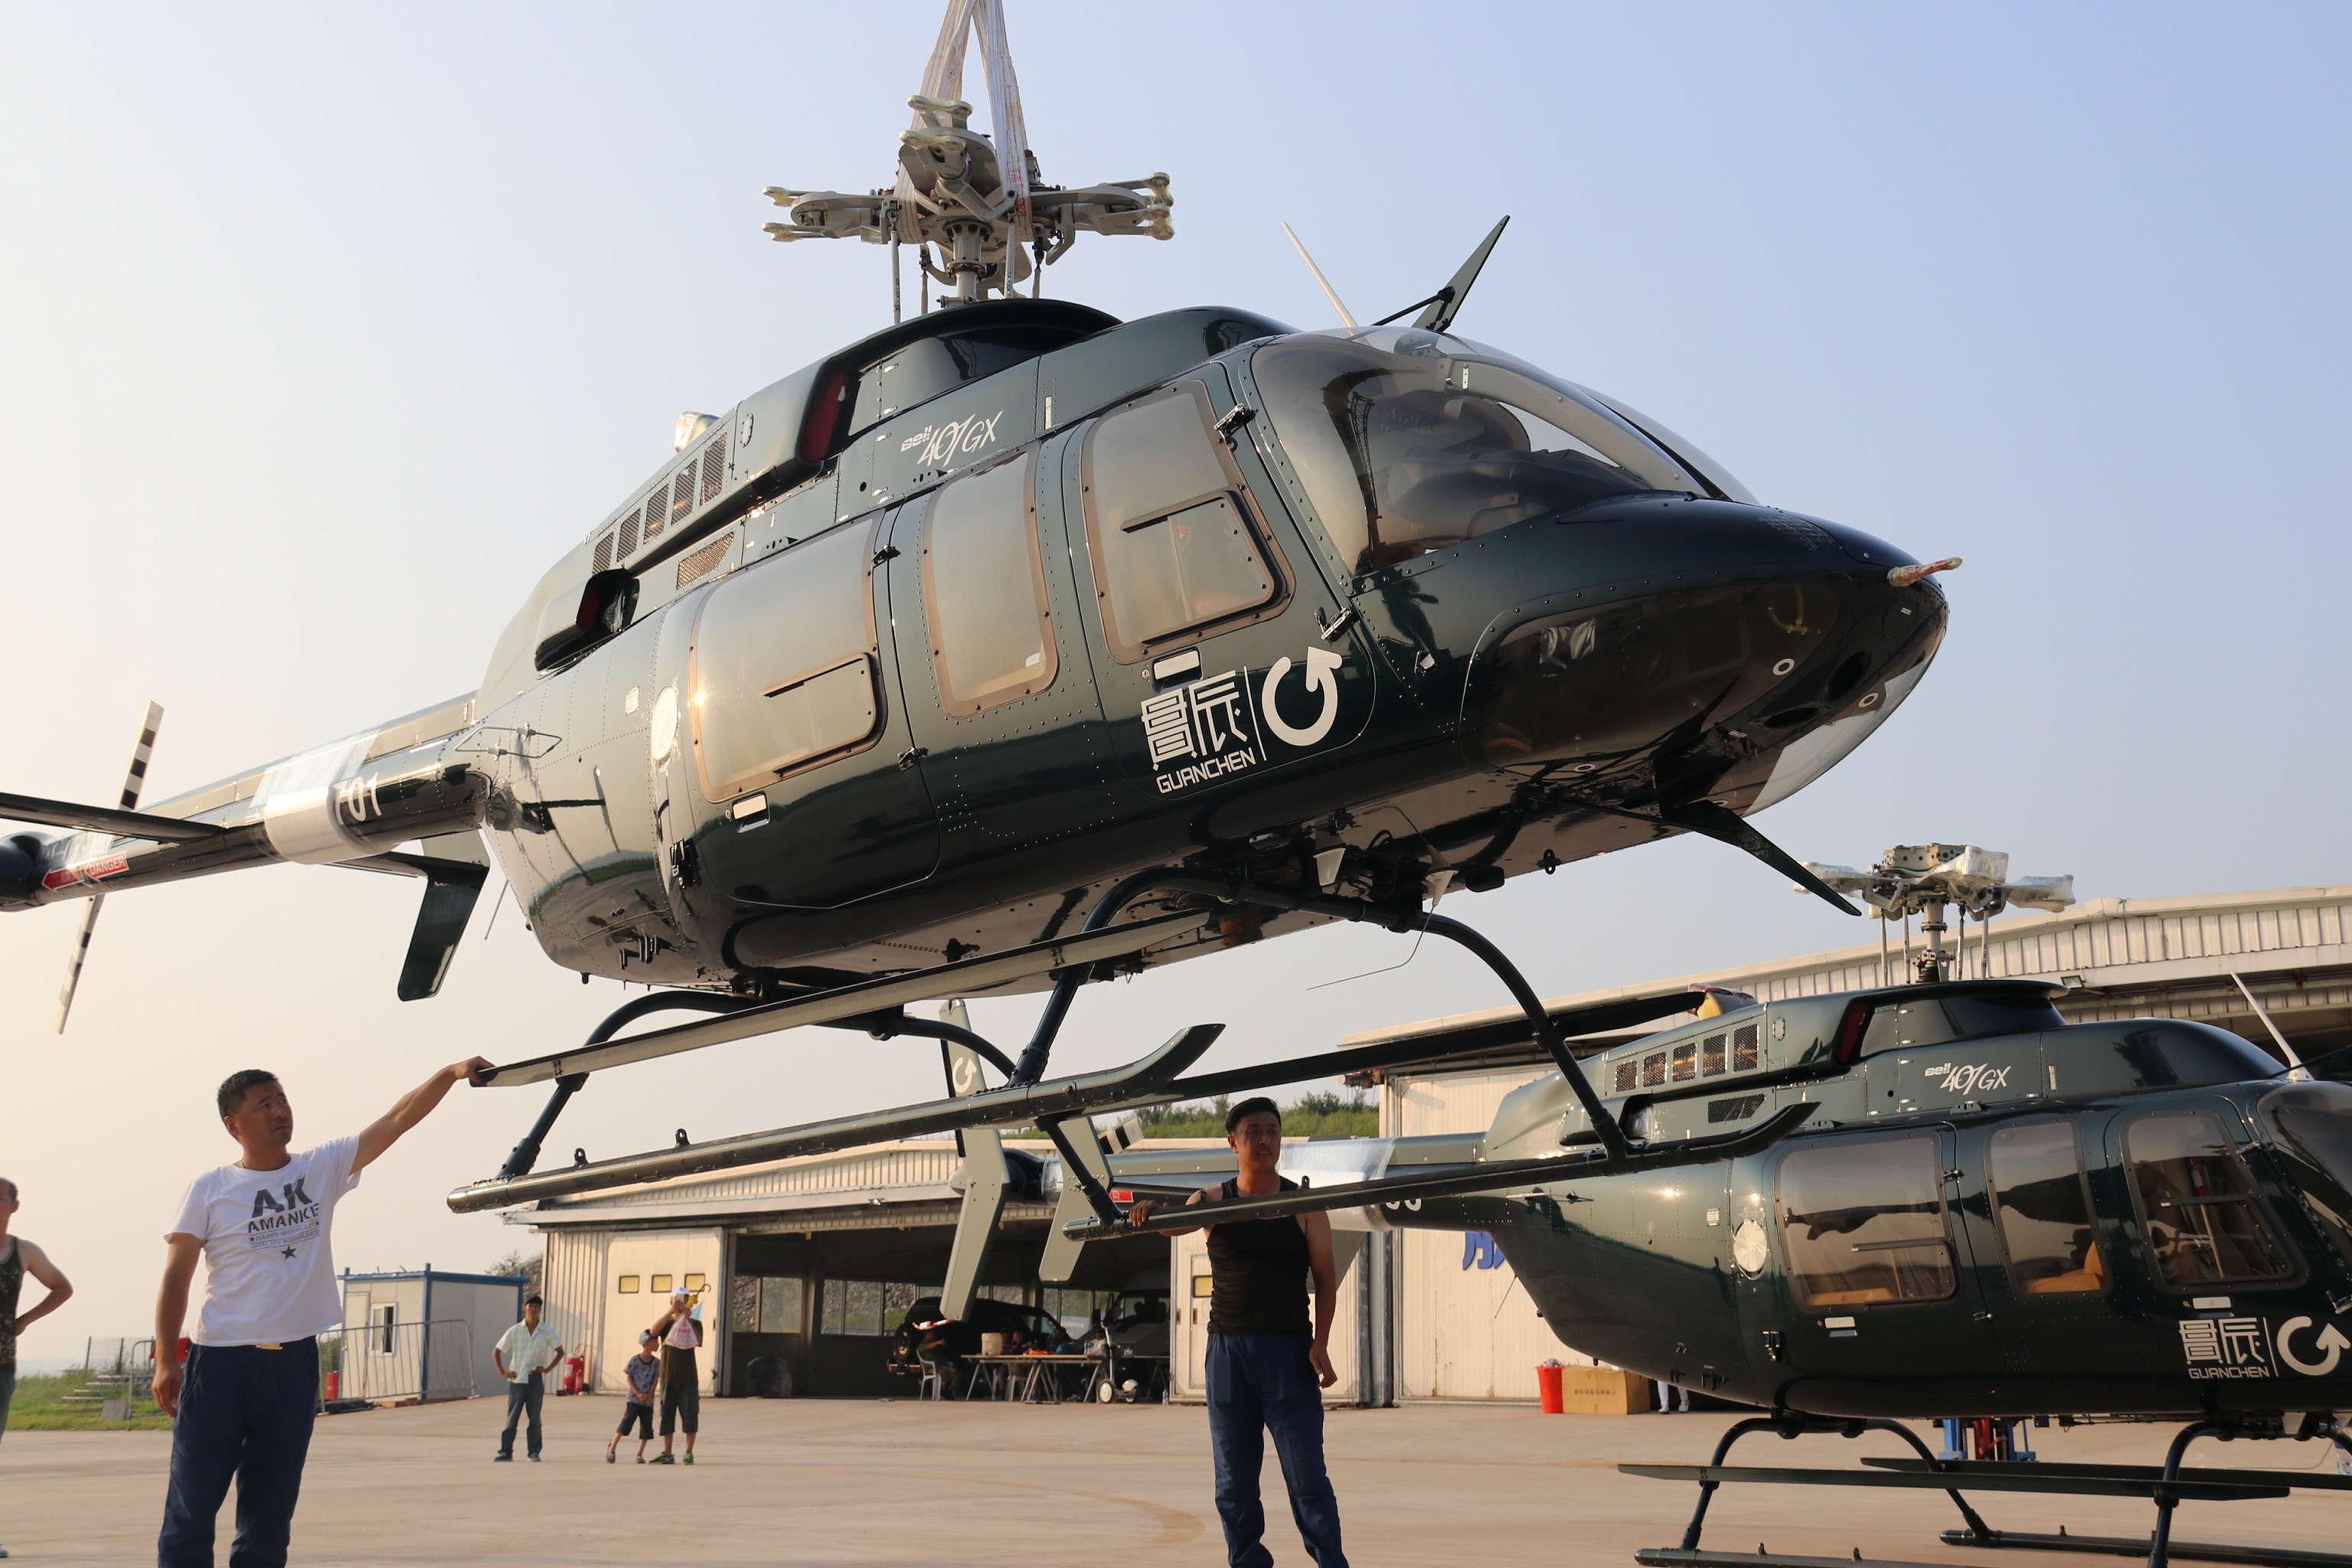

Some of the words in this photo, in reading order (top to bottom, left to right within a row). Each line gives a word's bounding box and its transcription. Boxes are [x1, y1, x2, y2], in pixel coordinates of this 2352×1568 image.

[900, 424, 933, 452] Bell
[1156, 746, 1256, 794] GUANCHEN
[90, 856, 126, 875] DANGER
[1924, 1062, 1952, 1077] Bell
[251, 1174, 313, 1218] AK
[250, 1240, 282, 1249] QUALITY
[283, 1229, 320, 1244] ASSURANCE
[256, 1231, 279, 1241] HAPPY
[280, 1226, 303, 1237] WORK
[2188, 1366, 2270, 1379] GUANCHEN
